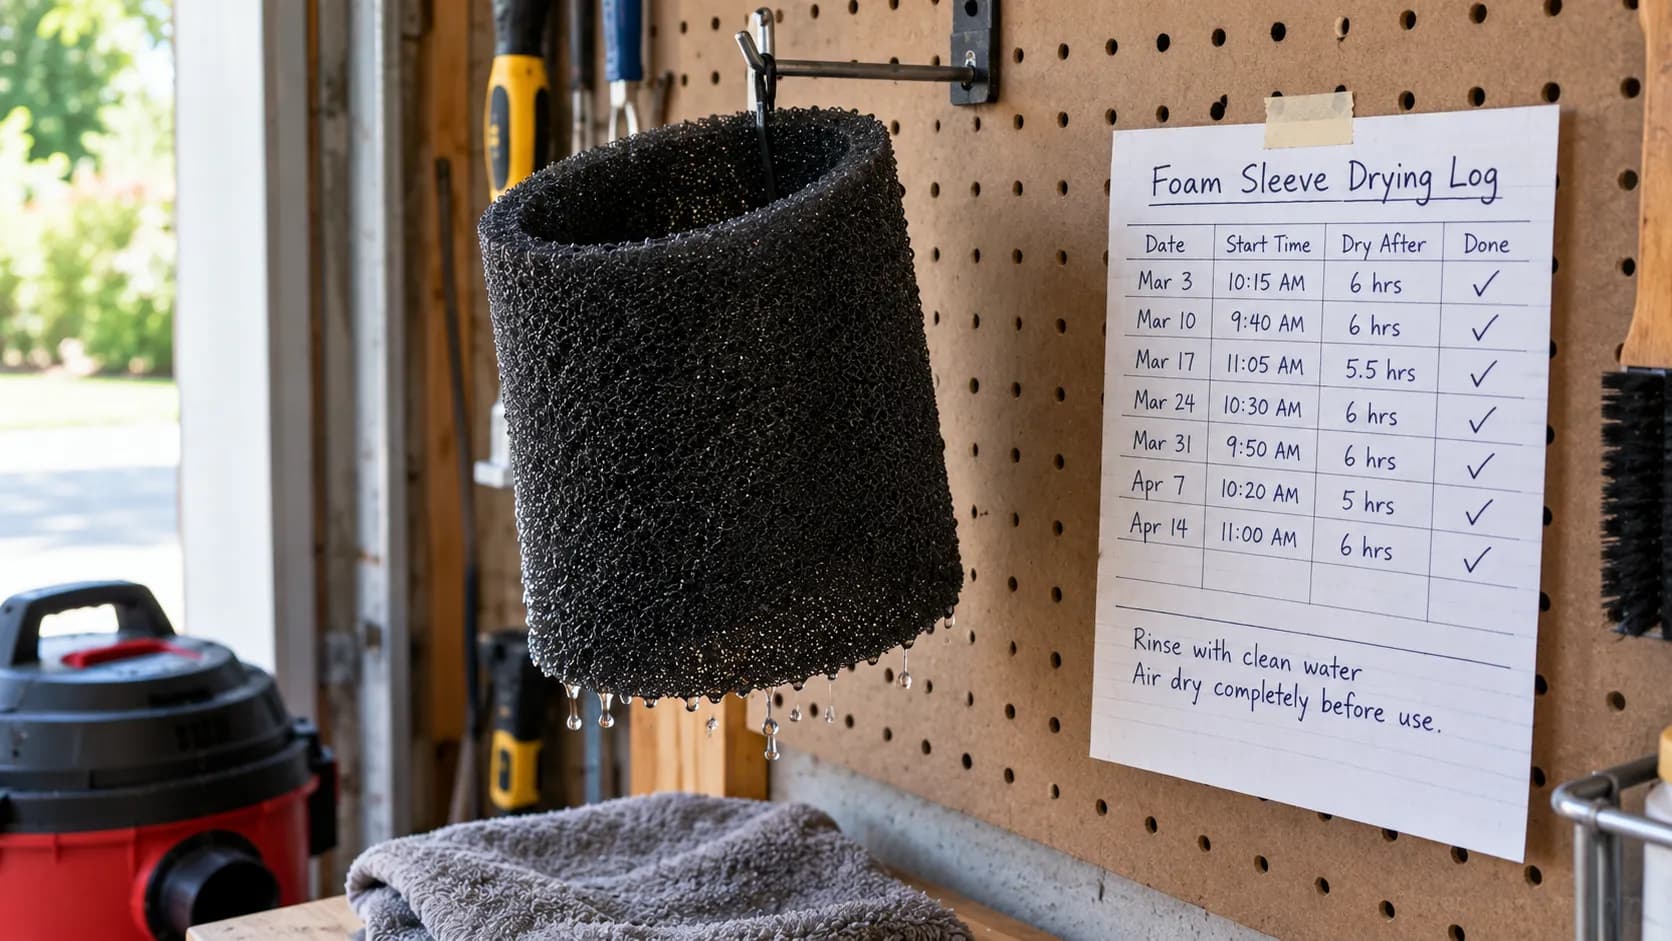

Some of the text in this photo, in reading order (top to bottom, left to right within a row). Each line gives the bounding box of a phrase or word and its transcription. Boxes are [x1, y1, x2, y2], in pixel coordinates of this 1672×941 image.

[1151, 154, 1501, 207] Foam Sleeve Drying Log
[1145, 233, 1186, 254] Date
[1225, 233, 1312, 254] Start Time
[1339, 231, 1428, 262] Dry After
[1463, 232, 1511, 255] Done
[1137, 269, 1193, 291] Mar 3
[1228, 271, 1306, 292] 10:15 AM
[1350, 273, 1403, 295] 6 hrs
[1136, 308, 1197, 331] Mar 10
[1230, 310, 1305, 334] 9:40 AM
[1348, 313, 1401, 338] 6 hrs
[1135, 348, 1195, 372] Mar 17
[1227, 353, 1305, 377] 11:05 AM
[1345, 357, 1416, 383] 5.5 hrs
[1133, 388, 1196, 414] Mar 24
[1224, 394, 1302, 419] 10:30 AM
[1345, 400, 1398, 427] 6 hrs
[1132, 429, 1192, 454] Mar 31
[1226, 435, 1301, 462] 9:50 AM
[1344, 444, 1397, 471] 6 hrs
[1129, 469, 1185, 499] Apr 7
[1221, 478, 1299, 505] 10:20 AM
[1341, 489, 1395, 516] 5 hrs
[1127, 511, 1189, 544] Apr 14
[1221, 521, 1297, 549] 11:00 AM
[1340, 532, 1393, 561] 6 hrs
[1133, 626, 1364, 682] Rinse with clean water
[1131, 661, 1441, 734] Air dry completely before use.
